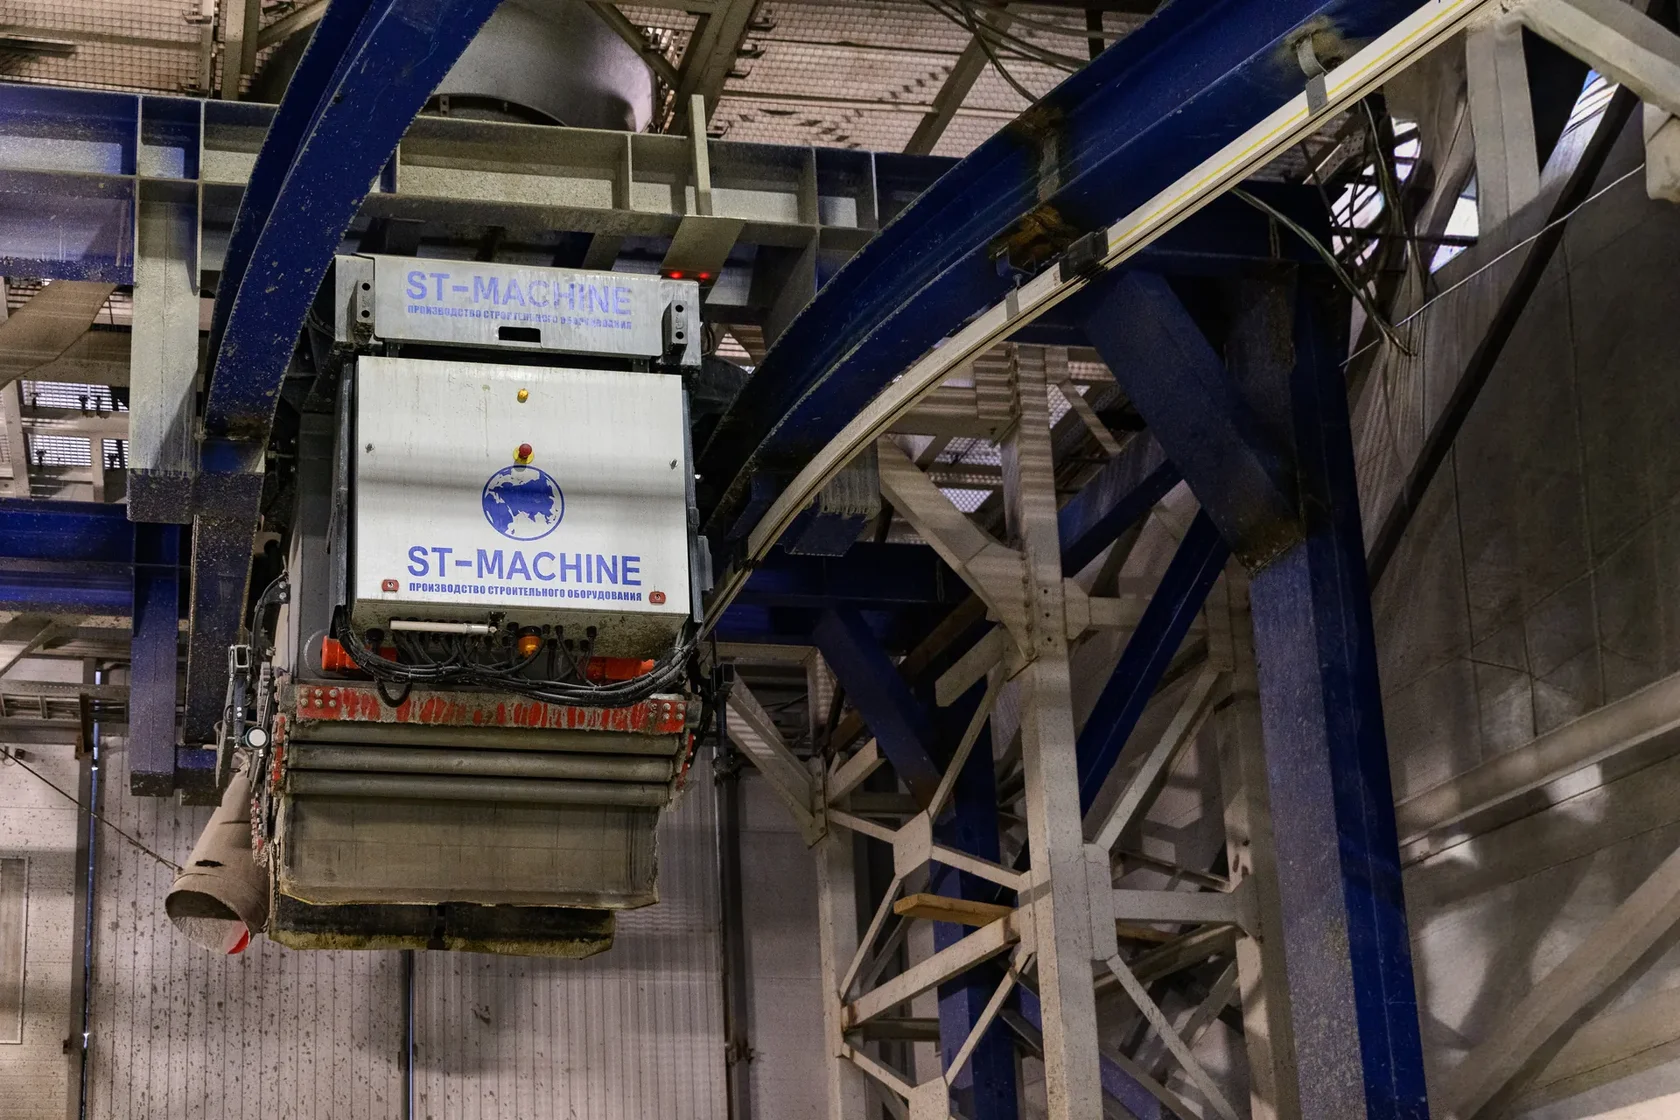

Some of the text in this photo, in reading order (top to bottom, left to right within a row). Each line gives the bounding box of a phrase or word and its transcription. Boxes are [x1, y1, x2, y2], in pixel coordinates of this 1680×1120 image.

[406, 270, 632, 316] ST-MACHINE
[407, 305, 481, 318] ПРОИЗВОДСТВО
[407, 545, 642, 586] ST-MACHINE
[409, 582, 642, 602] ПРОИЗВОДСТВО СТРОИТЕЛЬНОГО ОБОРУДОВАНИЯ
